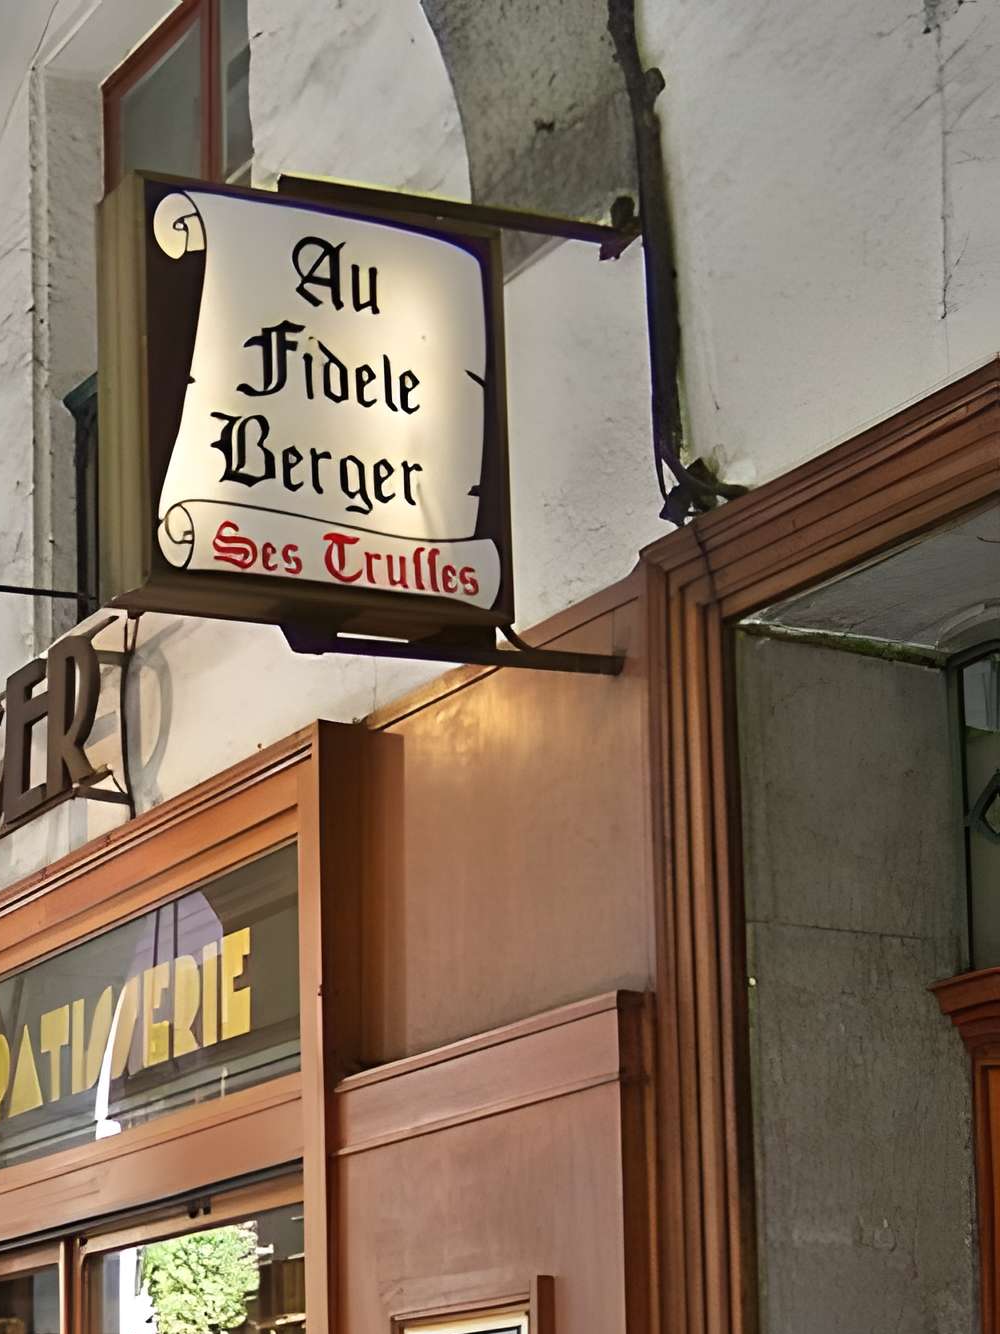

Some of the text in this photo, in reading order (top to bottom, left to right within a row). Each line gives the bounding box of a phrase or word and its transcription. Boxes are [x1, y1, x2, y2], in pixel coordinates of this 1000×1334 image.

[291, 235, 381, 315] Au
[236, 319, 421, 415] Fidele
[209, 411, 424, 515] Berger
[212, 519, 304, 575] Ses
